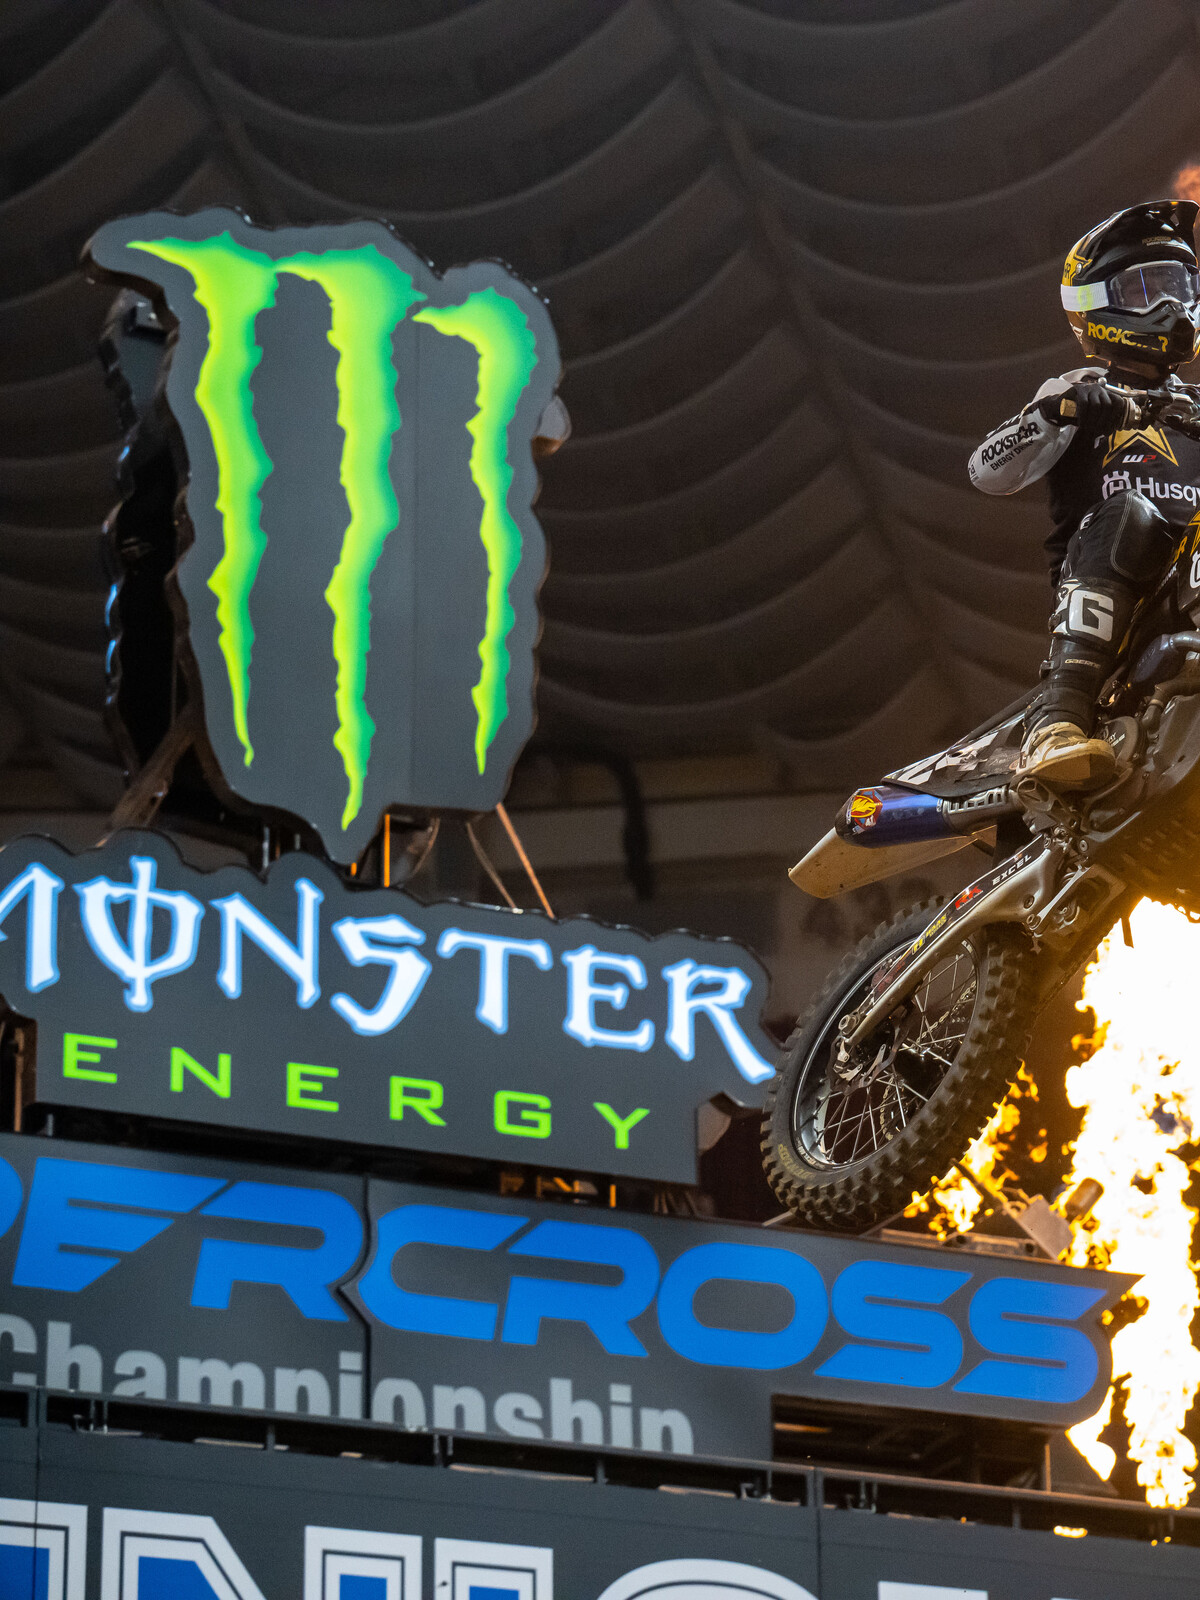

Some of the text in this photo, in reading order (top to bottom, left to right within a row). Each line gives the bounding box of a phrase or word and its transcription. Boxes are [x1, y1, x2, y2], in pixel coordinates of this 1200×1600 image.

[981, 421, 1041, 466] ROCKSTAR
[1122, 454, 1157, 464] WP
[990, 451, 1015, 471] ENERGY
[992, 854, 1032, 885] EXCEL
[955, 885, 983, 910] RK
[63, 1033, 650, 1149] ENERGY
[0, 1156, 1108, 1405] ERCROSS
